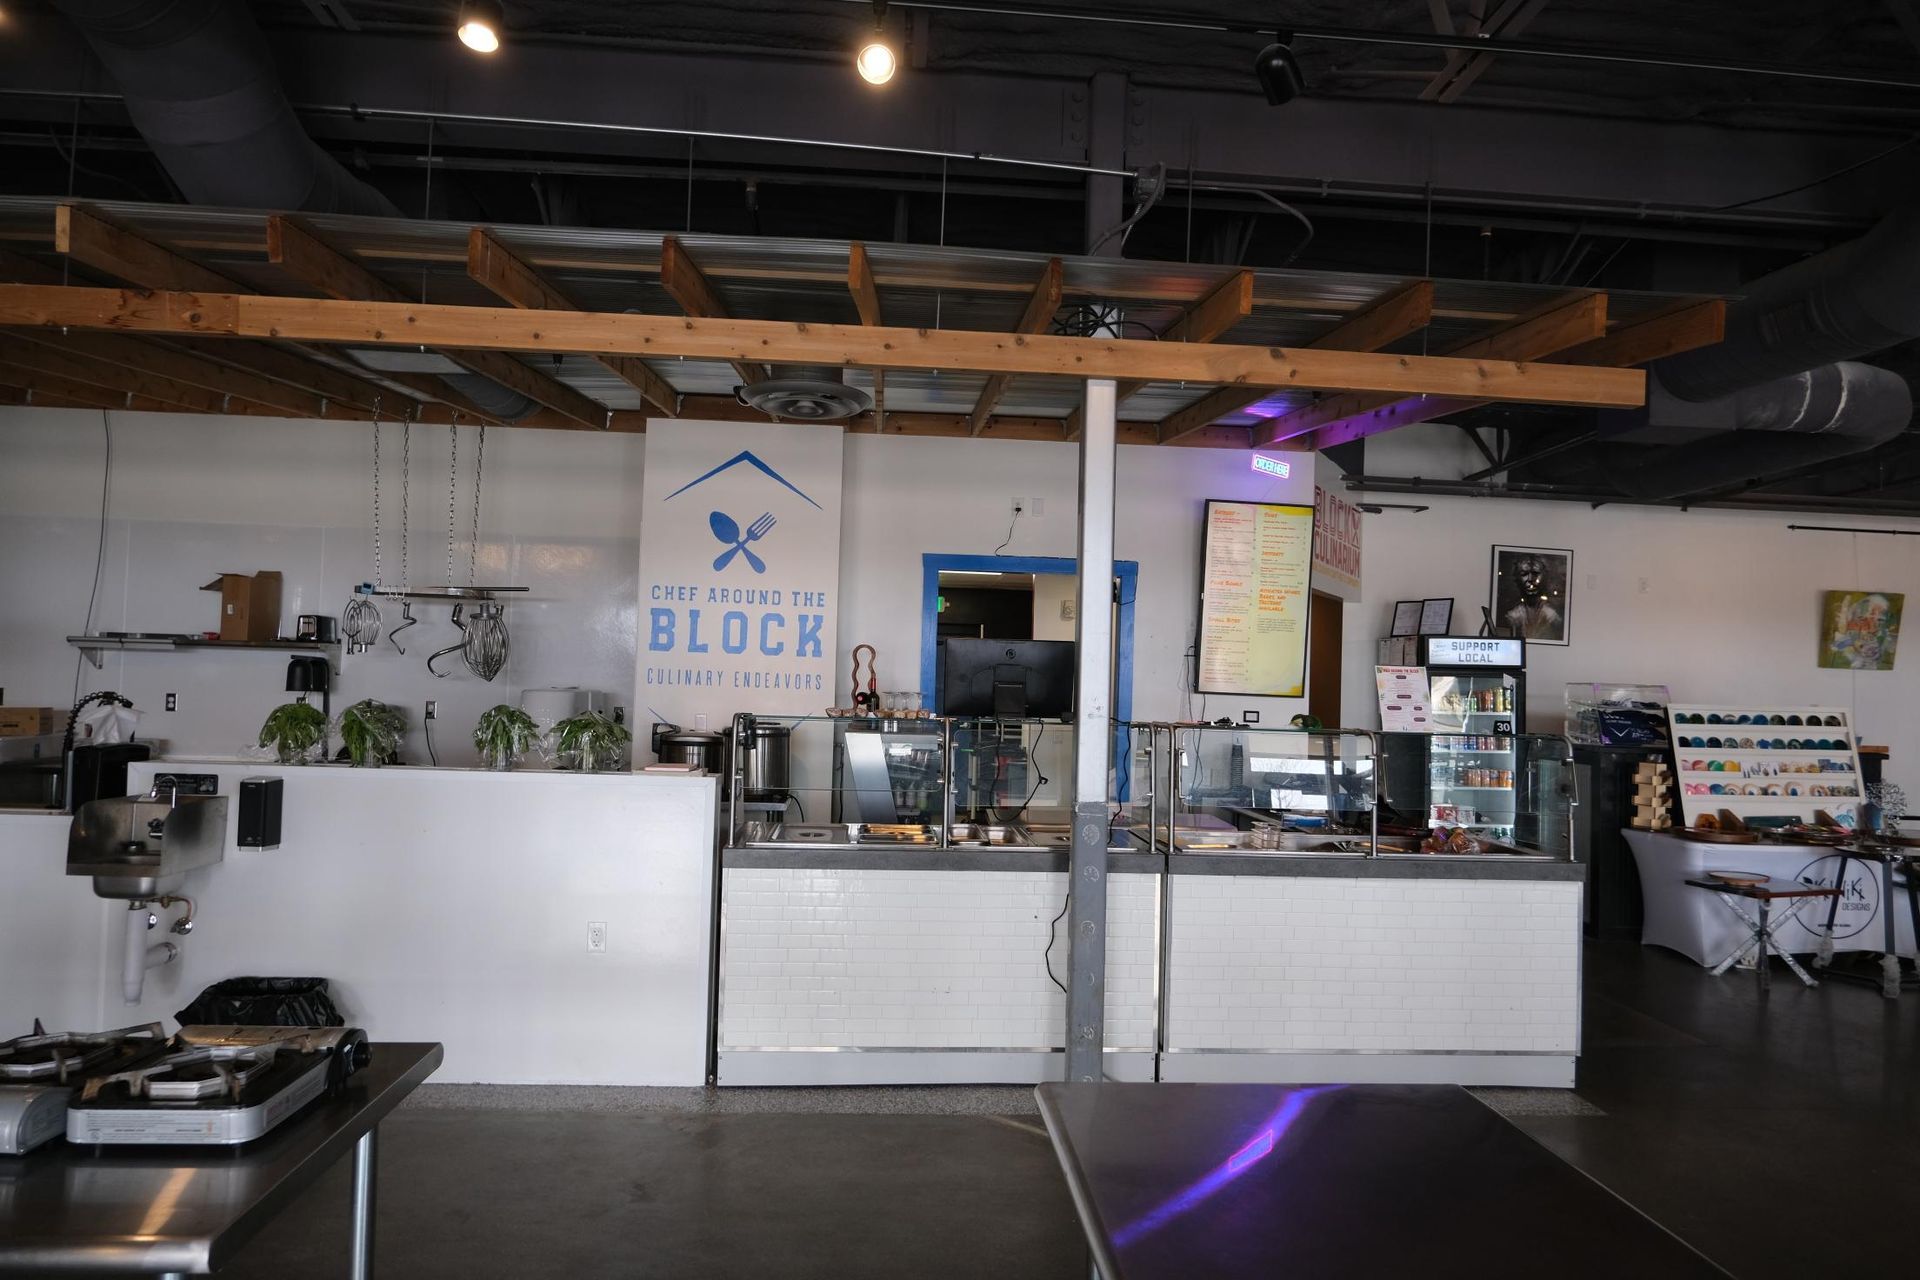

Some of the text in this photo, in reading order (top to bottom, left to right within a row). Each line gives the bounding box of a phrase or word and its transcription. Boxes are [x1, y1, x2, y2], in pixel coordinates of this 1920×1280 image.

[1256, 458, 1288, 477] ORDER HERE
[1313, 531, 1360, 578] CULINARIUM
[651, 585, 825, 608] CHEF AROUND THE
[649, 607, 824, 658] BLOCK
[1451, 641, 1500, 651] SUPPORT
[1458, 653, 1494, 663] LOCAL
[647, 668, 823, 690] CULINARY ENDEAVORS
[1496, 722, 1511, 732] 30
[1842, 902, 1871, 912] DESIGNS
